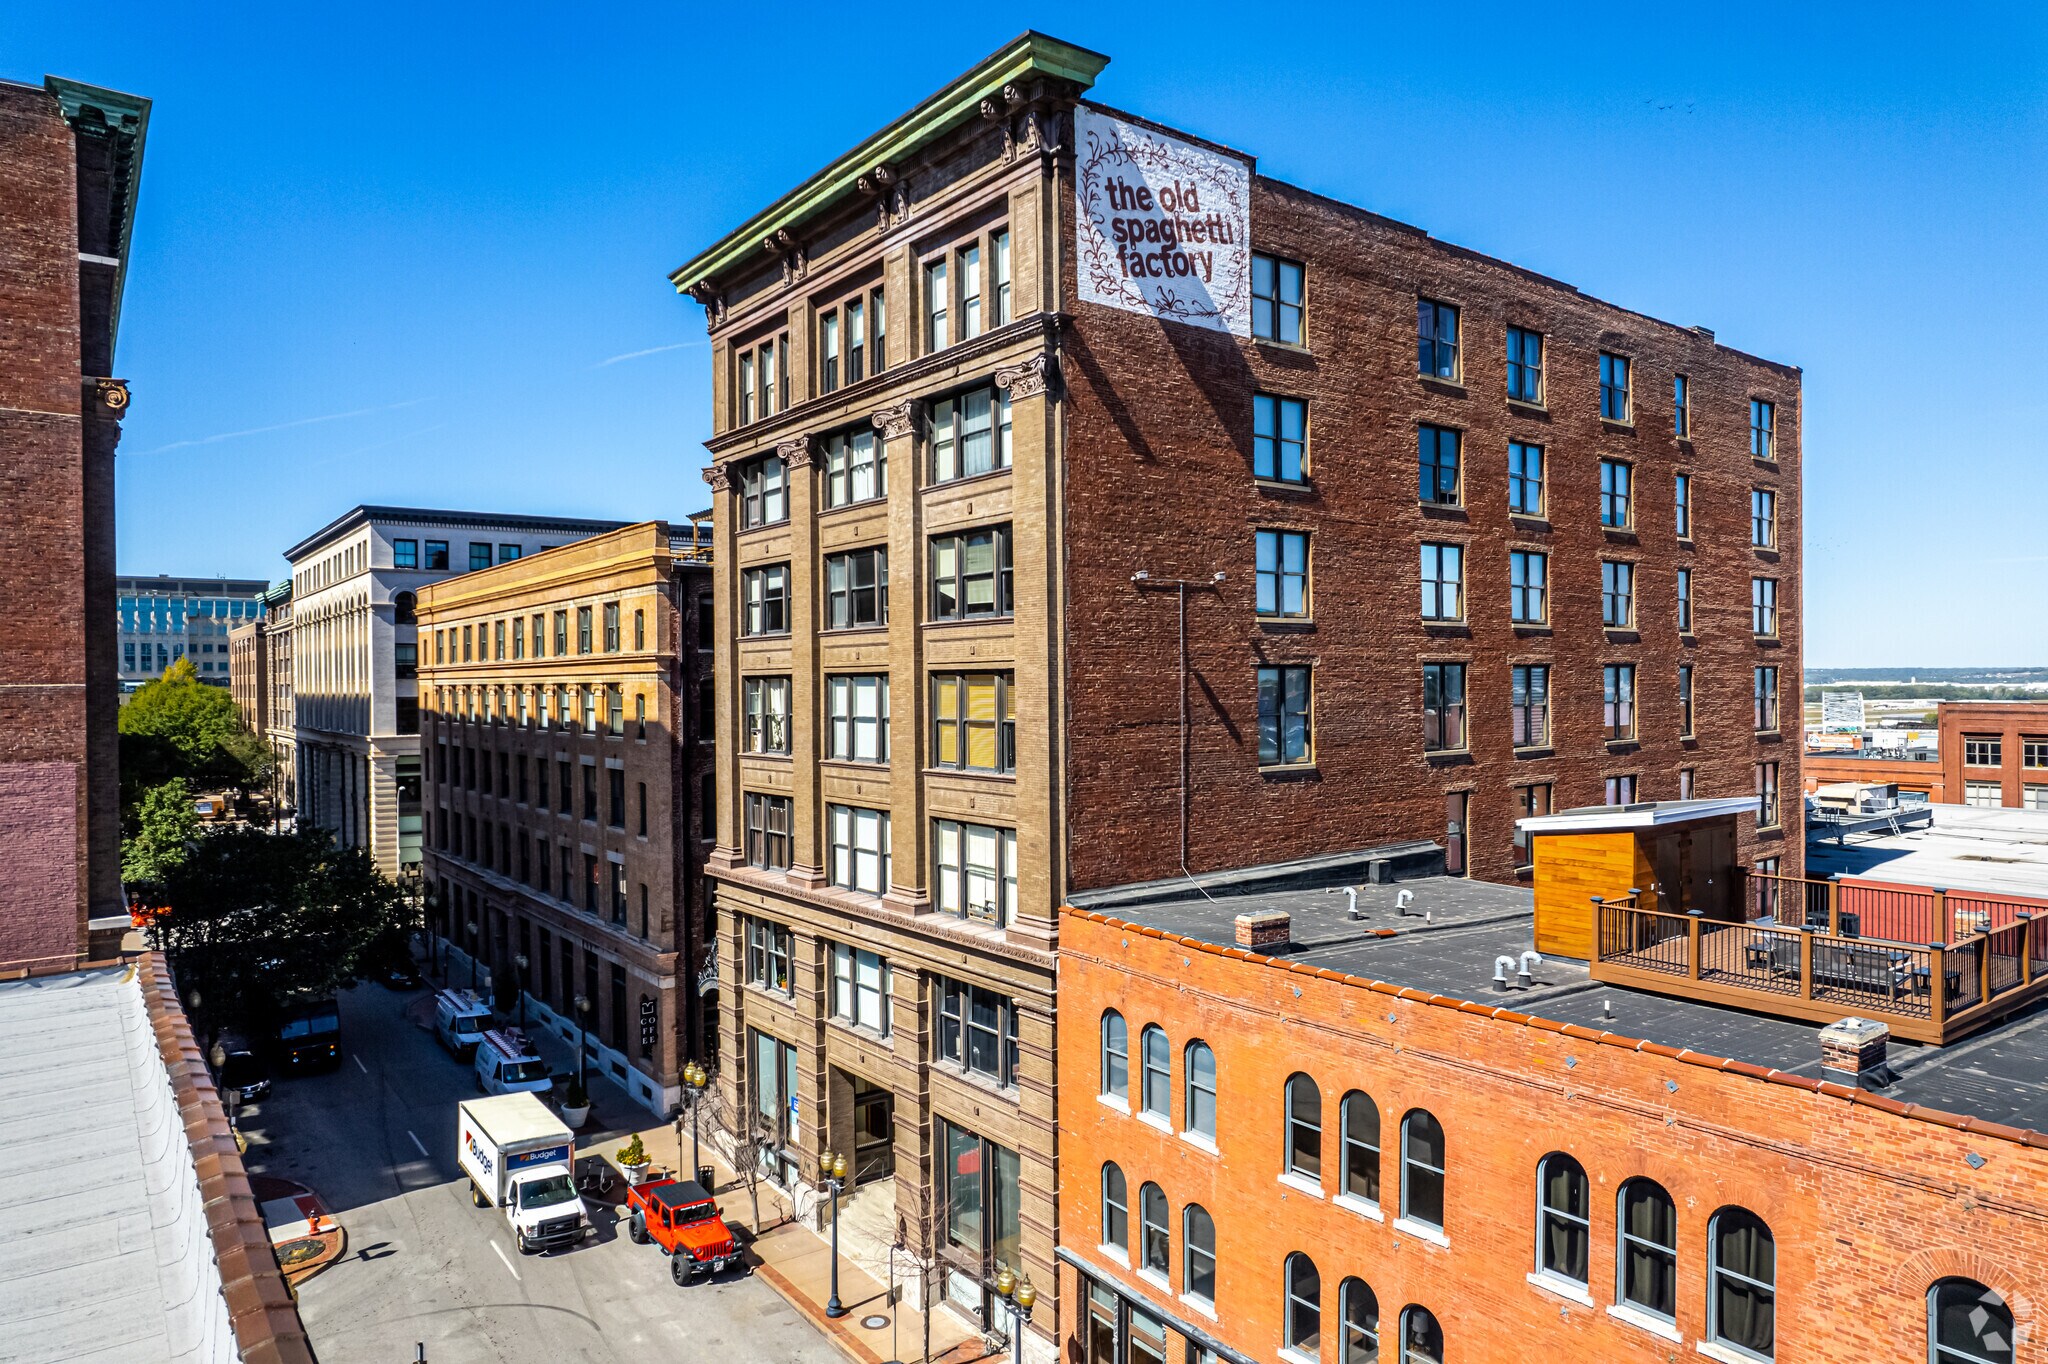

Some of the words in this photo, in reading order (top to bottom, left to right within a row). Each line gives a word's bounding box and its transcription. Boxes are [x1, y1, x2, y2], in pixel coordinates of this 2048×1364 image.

[1105, 176, 1154, 211] the
[1159, 180, 1200, 213] old
[1111, 210, 1234, 251] spaghetti
[1116, 243, 1213, 284] factory
[472, 1138, 493, 1177] Budget
[529, 1148, 557, 1160] Budget
